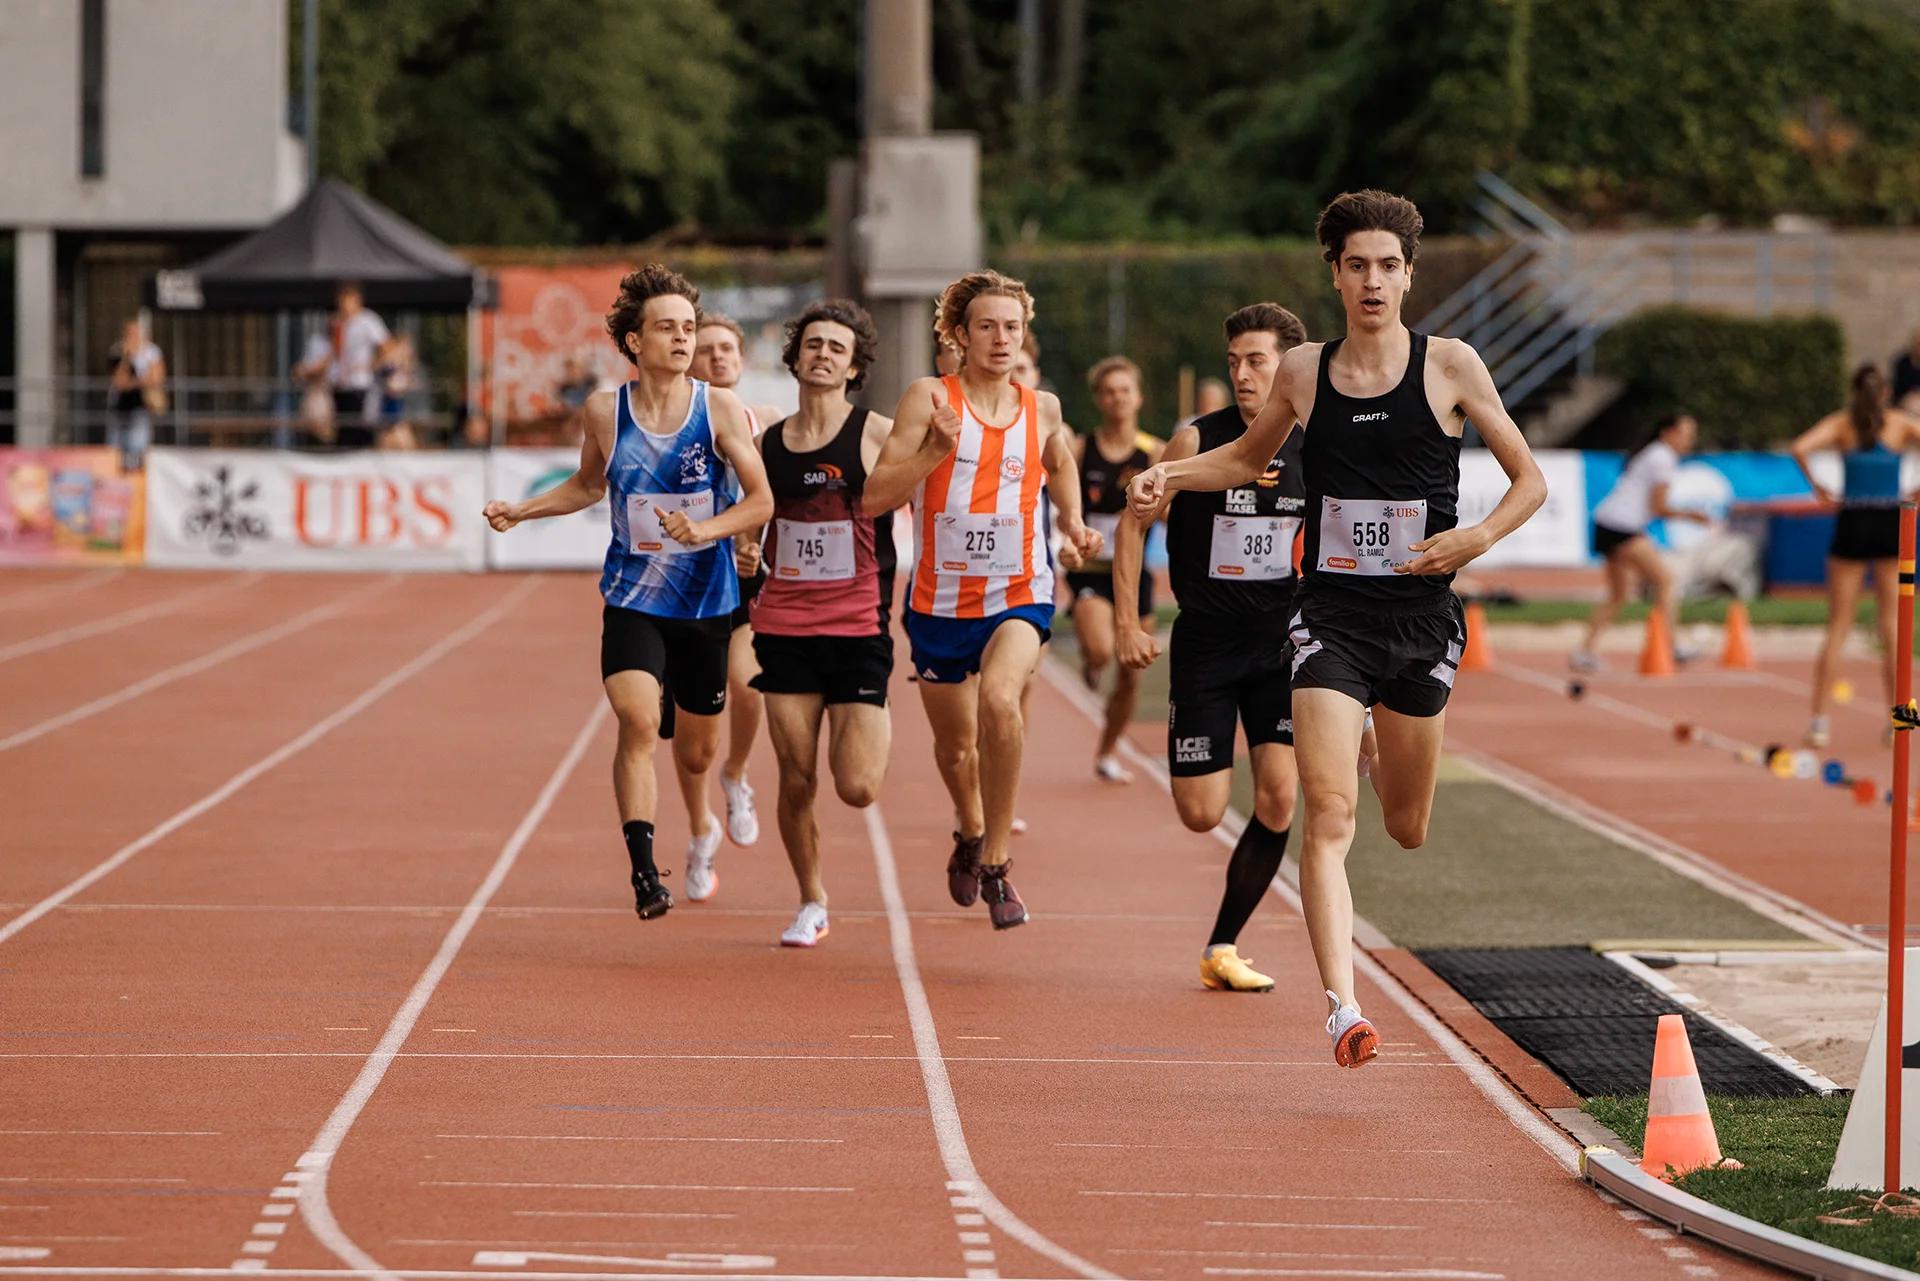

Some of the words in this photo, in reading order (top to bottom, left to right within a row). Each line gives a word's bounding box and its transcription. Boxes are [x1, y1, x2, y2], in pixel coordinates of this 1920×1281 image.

[1353, 413, 1381, 422] CRAFT
[803, 472, 827, 485] SAB
[1226, 489, 1257, 505] LCB
[292, 477, 454, 548] UBS
[1225, 504, 1258, 514] BASEL
[1396, 508, 1419, 518] UBS
[1001, 519, 1018, 527] UBS
[965, 531, 996, 551] 275
[1353, 522, 1390, 547] 558
[796, 539, 824, 558] 745
[1243, 535, 1273, 555] 383
[1176, 736, 1211, 753] LCB
[1176, 751, 1212, 763] BASEL
